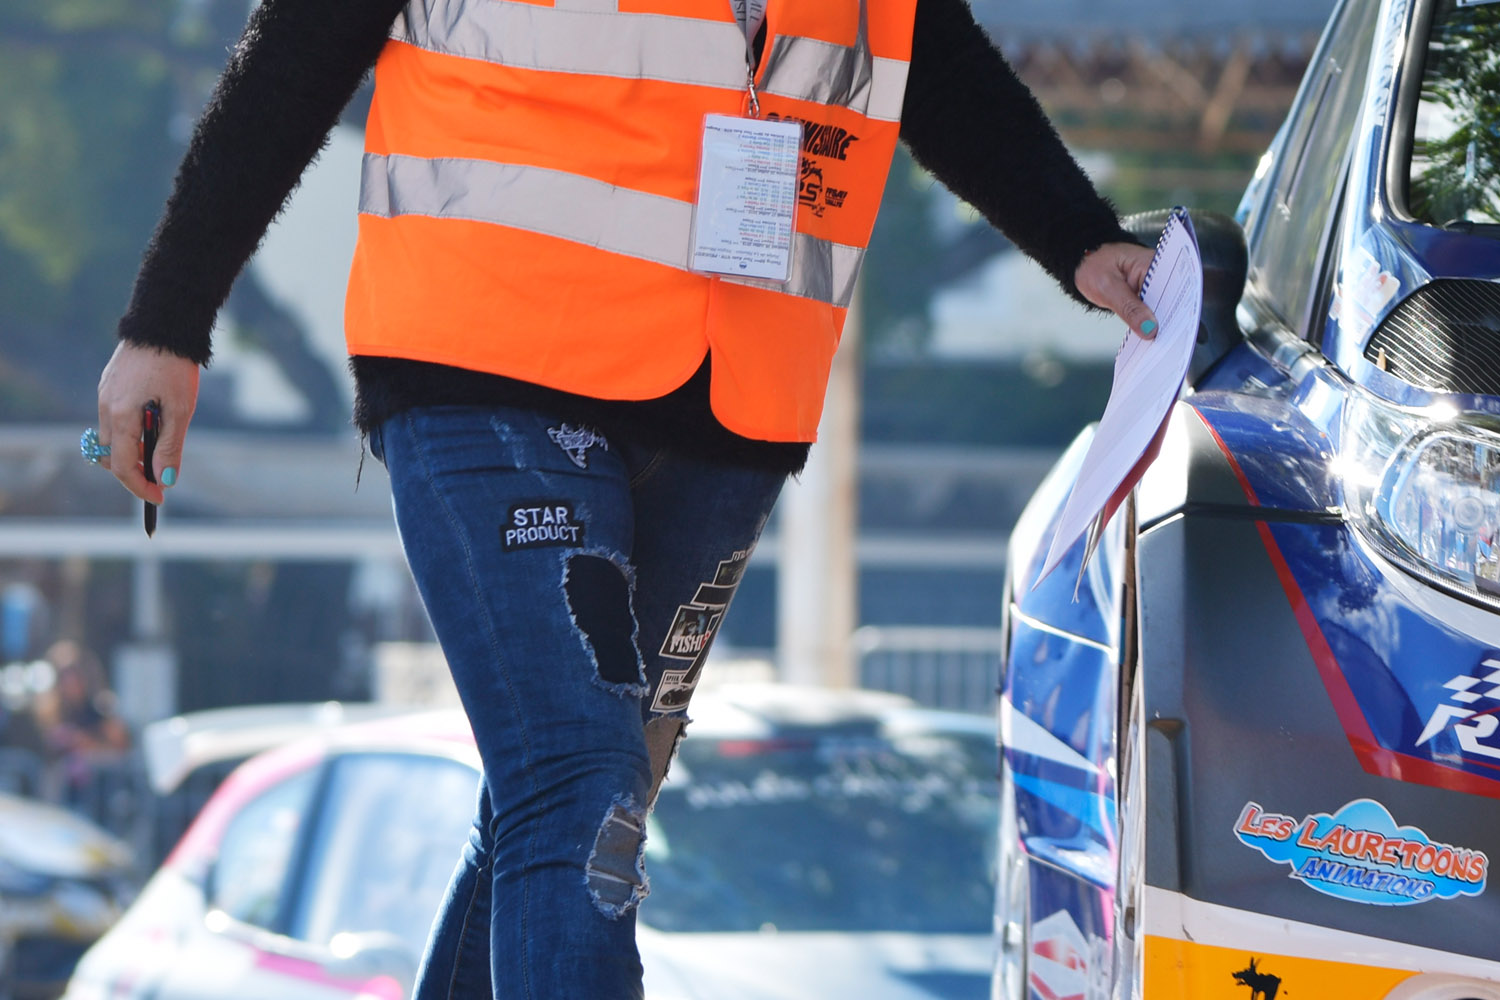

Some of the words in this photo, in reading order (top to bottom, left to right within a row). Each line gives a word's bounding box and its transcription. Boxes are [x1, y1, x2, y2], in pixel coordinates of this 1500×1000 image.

[513, 506, 568, 526] STAR
[505, 525, 580, 546] PRODUCT
[1238, 806, 1294, 842] LES
[1296, 818, 1487, 884] LAURETOONS
[1297, 856, 1436, 900] ANIMATIONS
